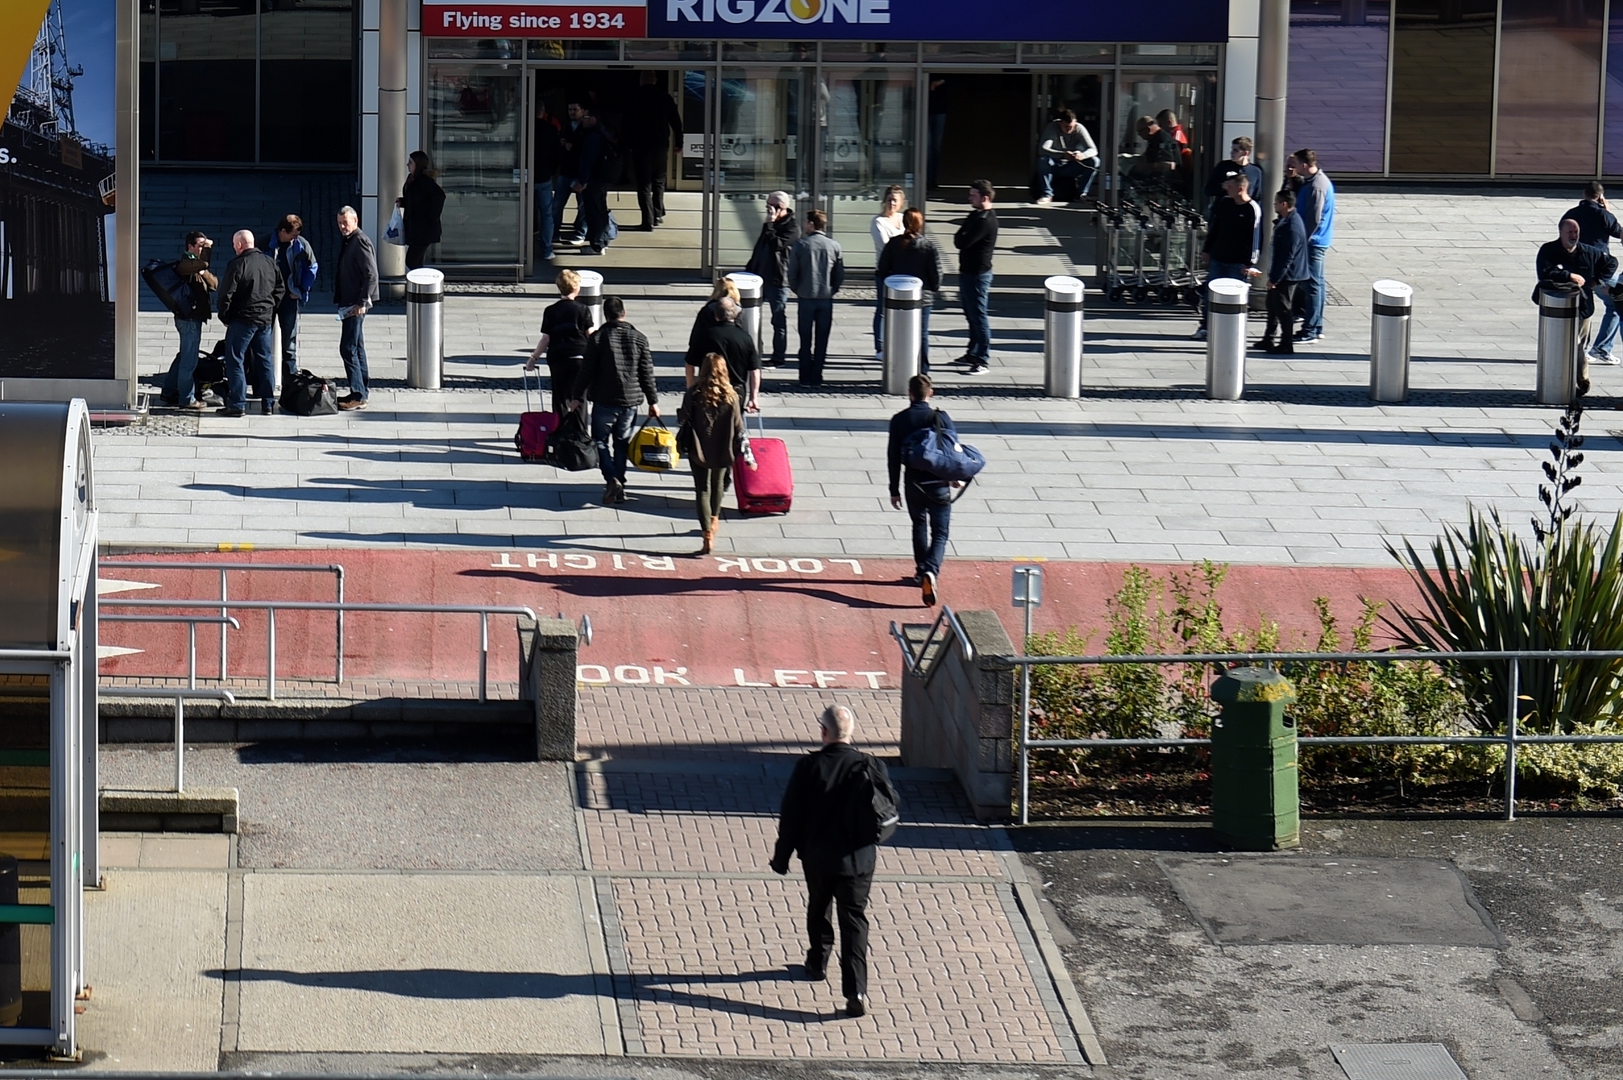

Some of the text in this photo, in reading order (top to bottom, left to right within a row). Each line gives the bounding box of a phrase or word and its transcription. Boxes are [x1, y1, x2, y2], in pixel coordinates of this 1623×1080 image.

[443, 11, 625, 30] Flying since 1934
[490, 551, 864, 575] LOOK RIGHT
[576, 665, 887, 689] OOK LEFT
